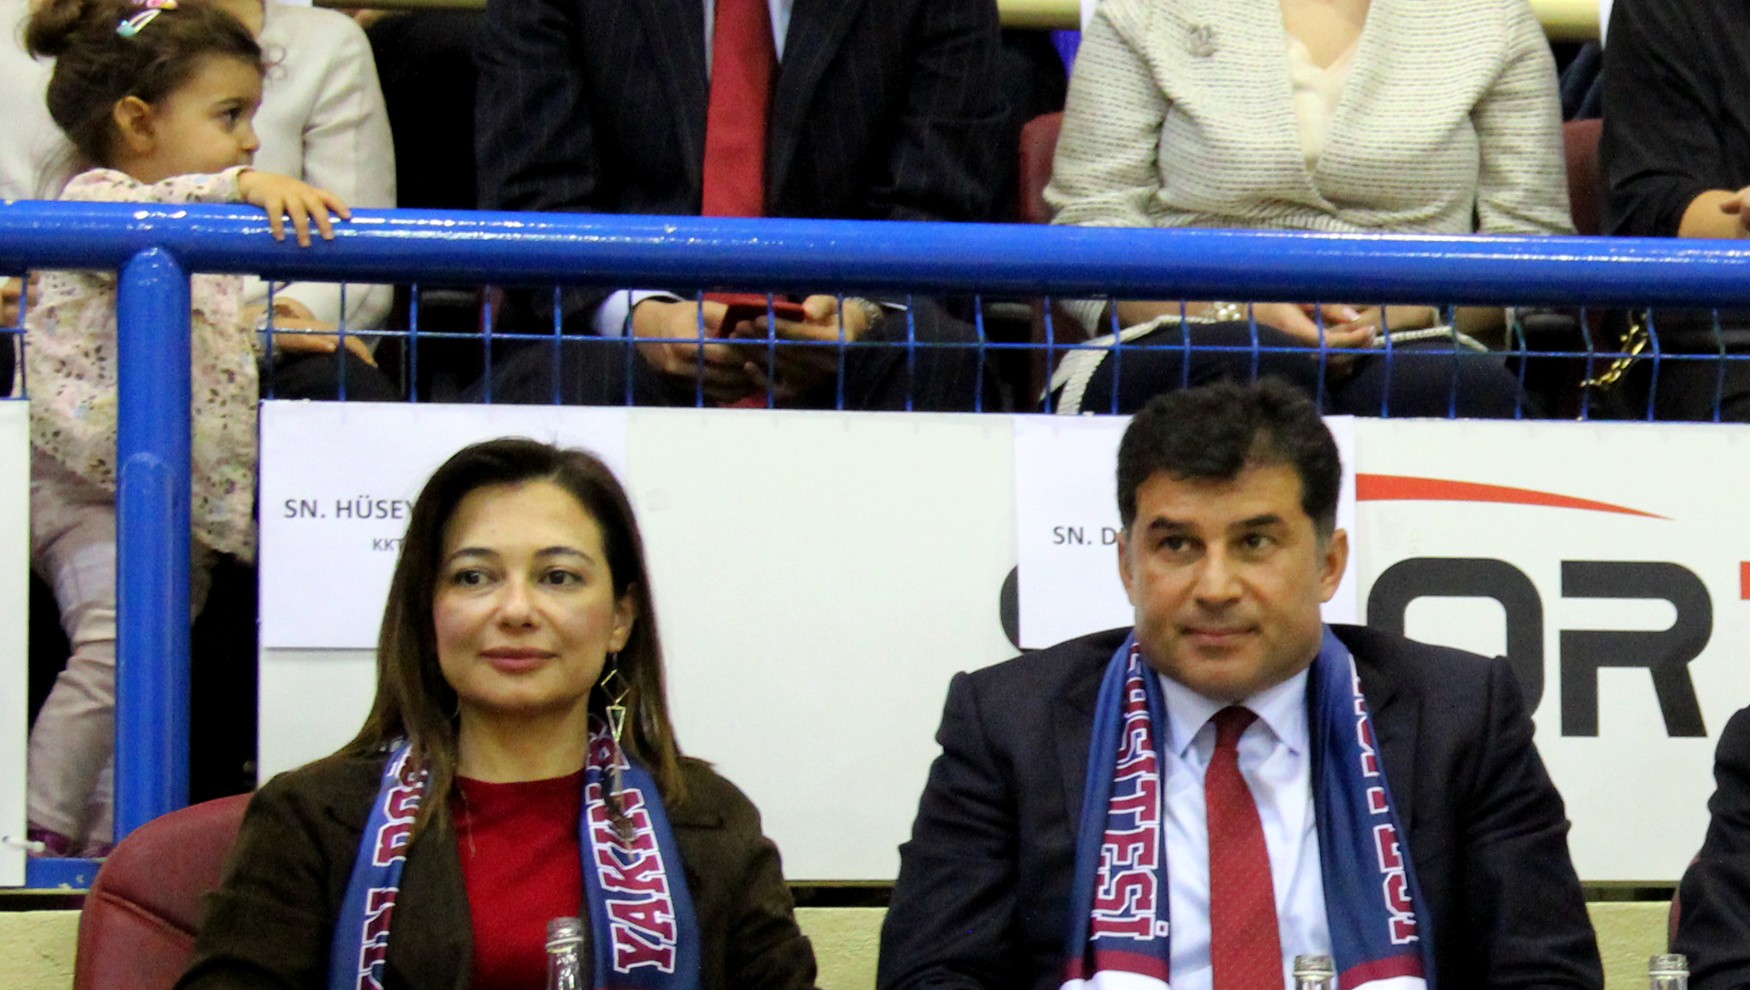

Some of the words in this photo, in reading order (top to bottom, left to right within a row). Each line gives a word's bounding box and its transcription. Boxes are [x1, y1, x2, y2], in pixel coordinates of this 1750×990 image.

[284, 499, 327, 519] SN.
[1053, 526, 1092, 545] SN.
[585, 782, 678, 974] YAKIN
